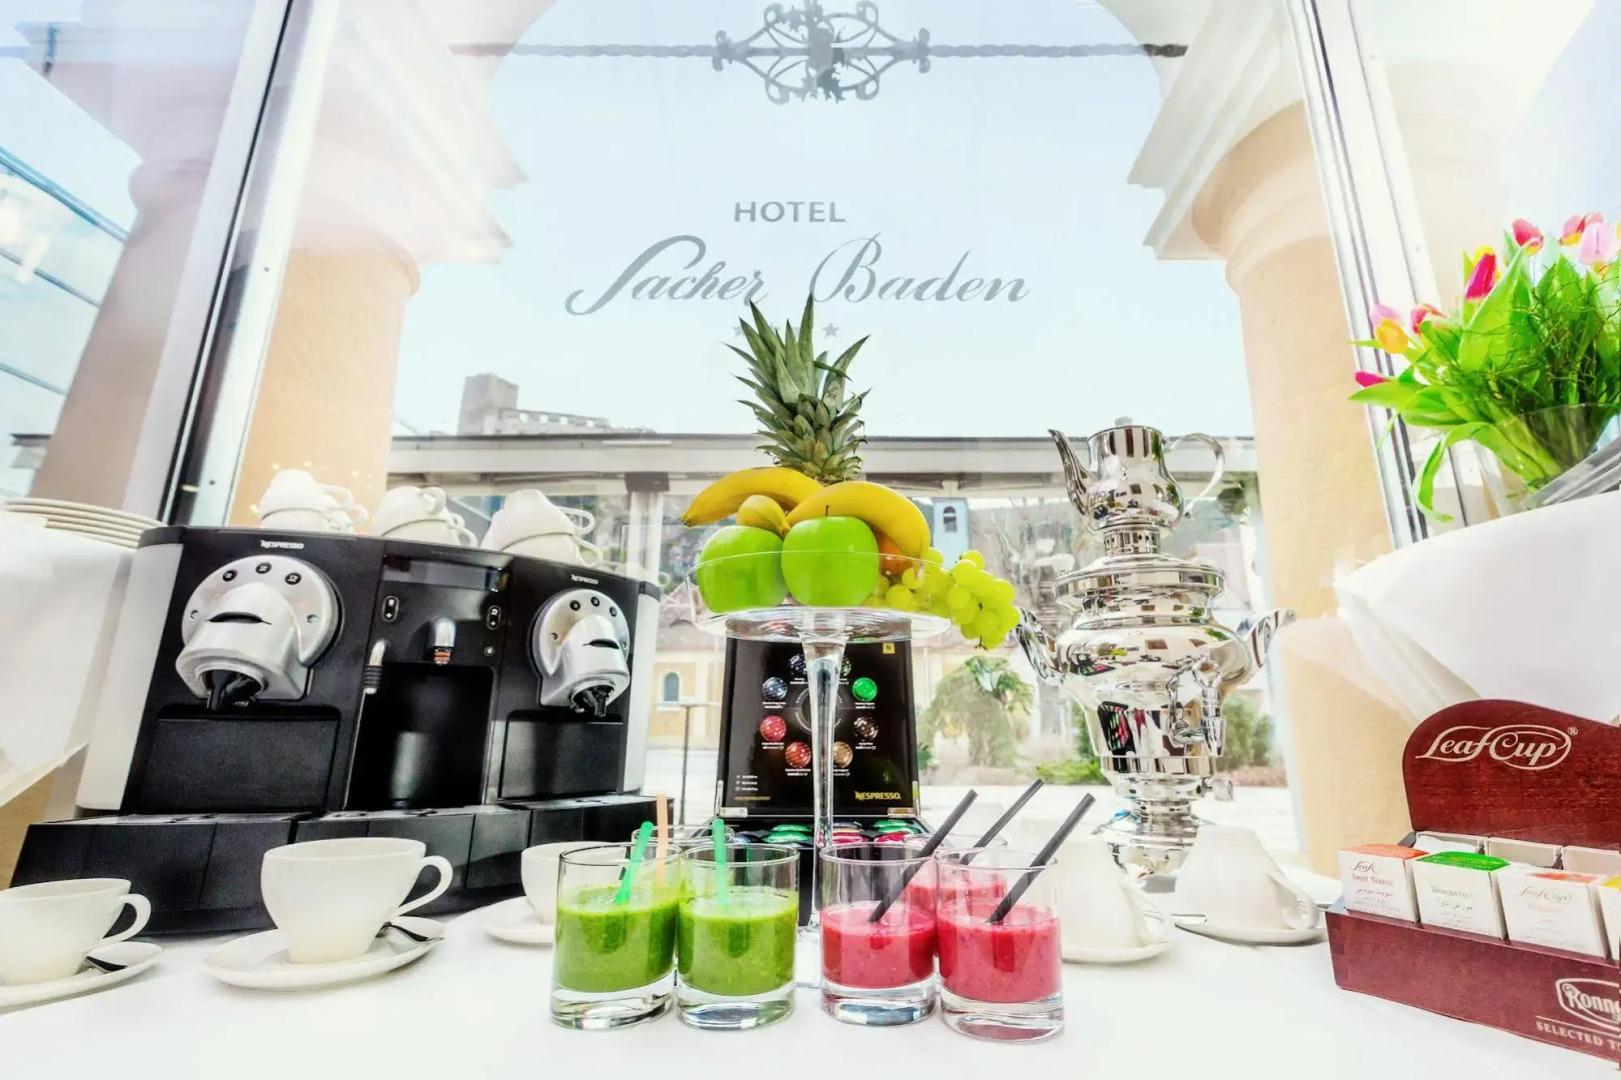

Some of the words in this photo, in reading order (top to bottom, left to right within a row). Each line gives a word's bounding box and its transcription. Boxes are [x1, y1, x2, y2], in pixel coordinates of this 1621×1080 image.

[733, 201, 846, 223] HOTEL
[564, 234, 769, 316] Sacher
[808, 231, 1031, 303] Baden
[1536, 1021, 1604, 1047] SELECTED
